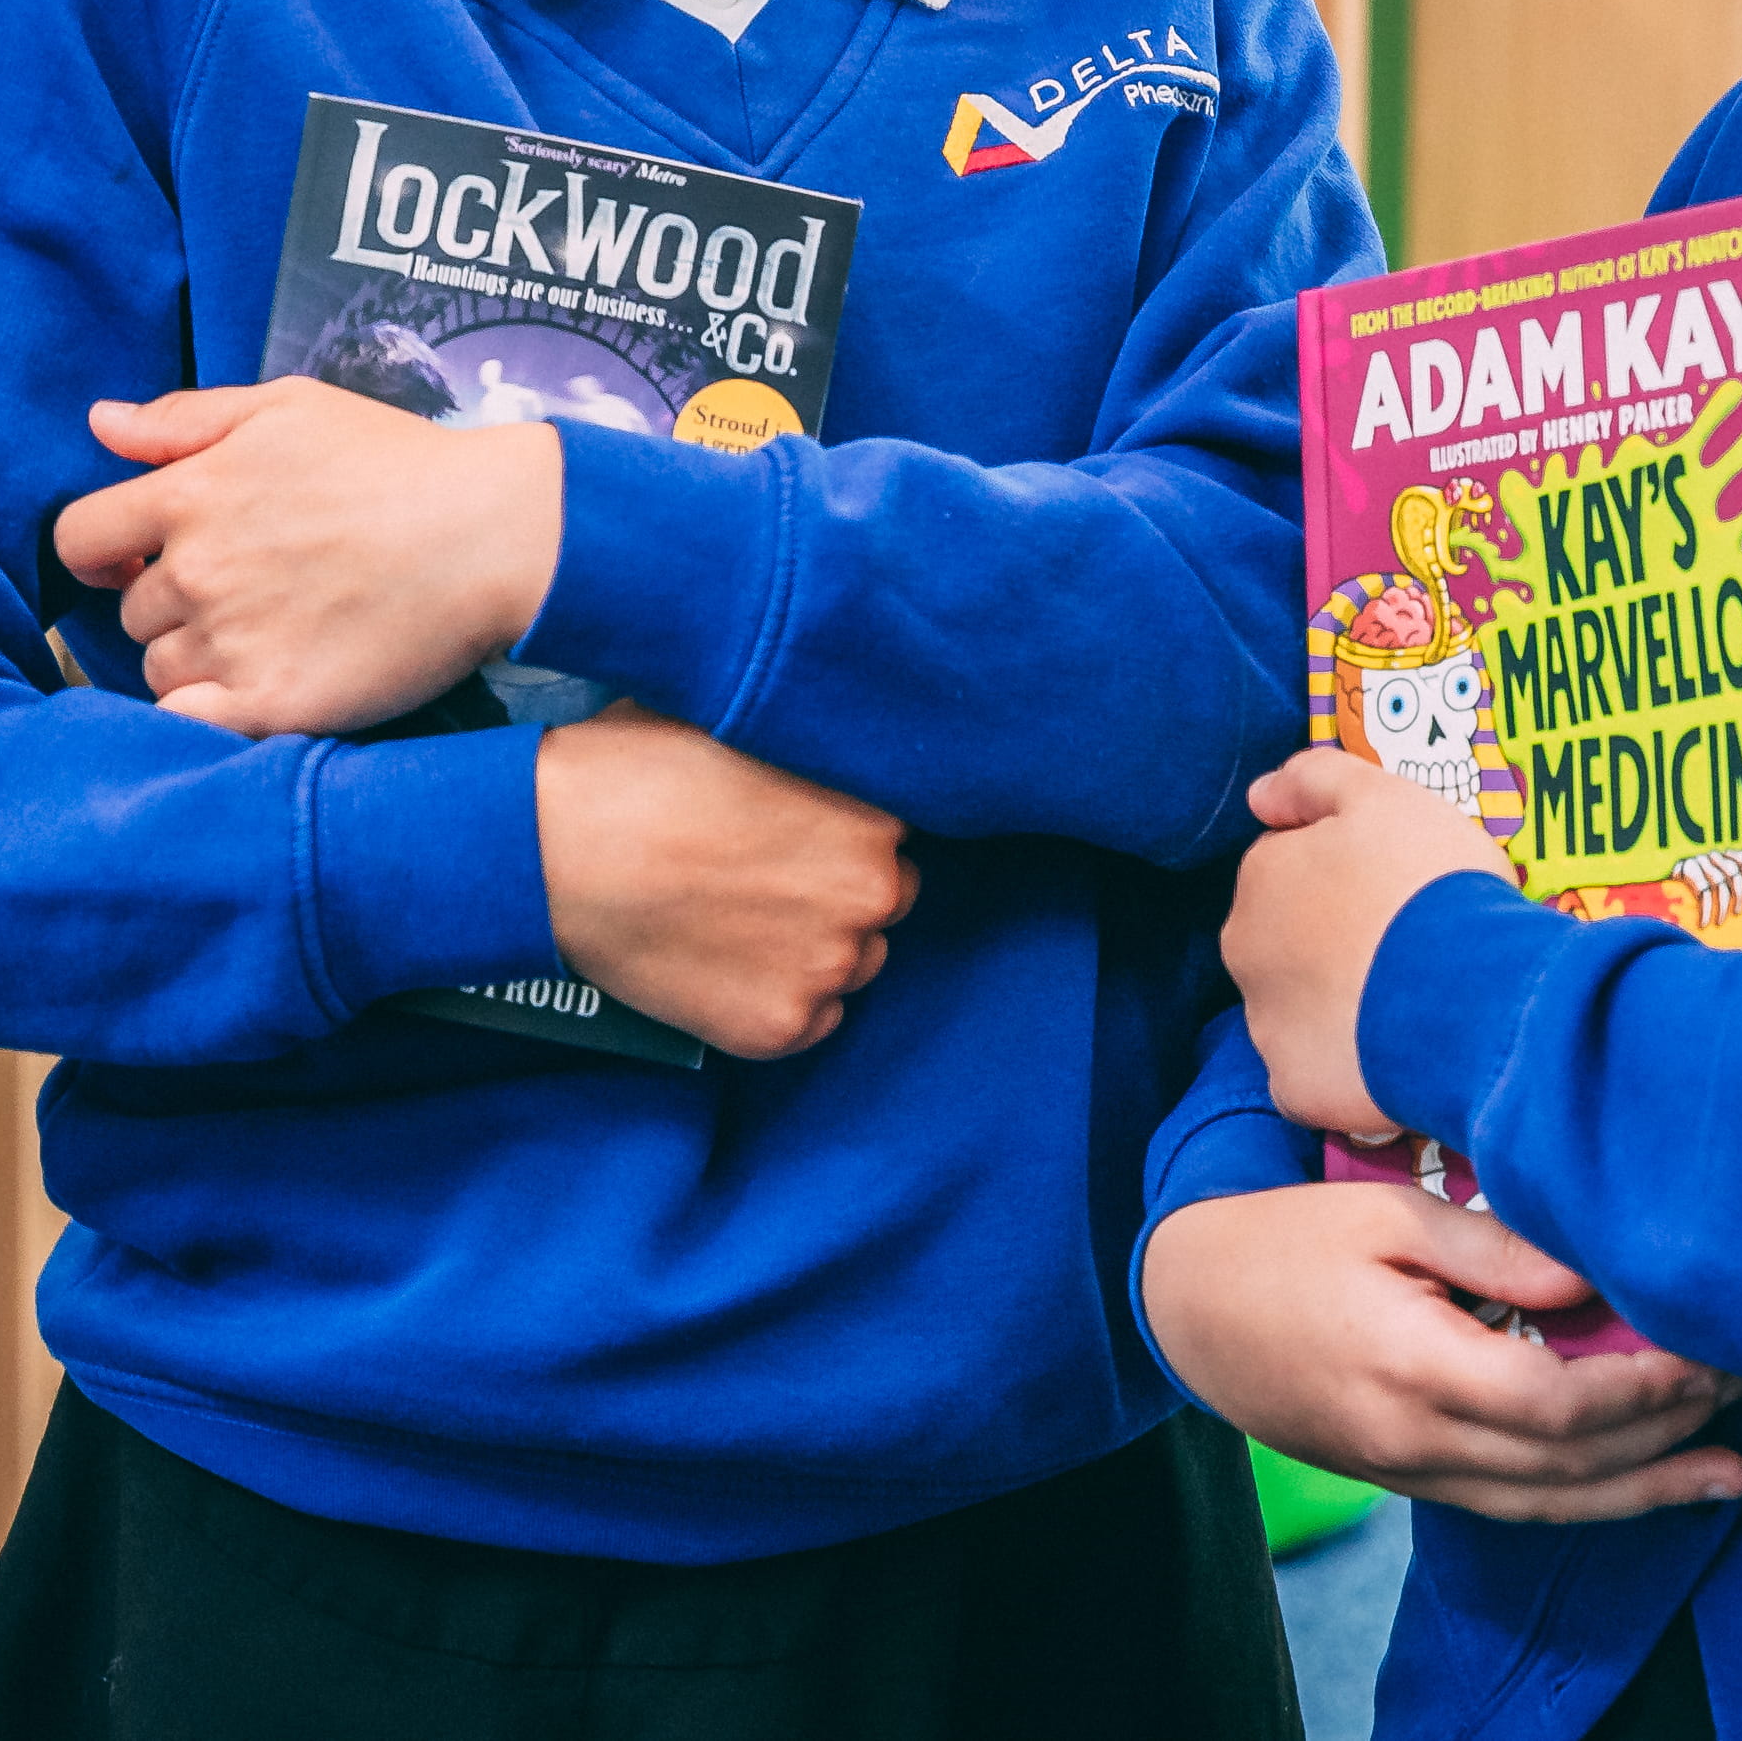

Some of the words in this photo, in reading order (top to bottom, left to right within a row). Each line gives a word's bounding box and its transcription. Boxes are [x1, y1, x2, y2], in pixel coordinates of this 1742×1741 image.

[1030, 25, 1198, 112] DELTA
[635, 162, 687, 187] Metro
[412, 255, 509, 296] Hauntings
[511, 279, 545, 302] are
[547, 286, 582, 310] our
[1350, 309, 1389, 339] FROM
[1390, 302, 1414, 330] THE
[1416, 272, 1556, 324] RECORD-BREAKING
[1559, 259, 1615, 294] AUTHOR
[1616, 253, 1637, 282] OF
[1638, 240, 1685, 278] KAY'S
[1351, 310, 1586, 450] ADAM
[1429, 432, 1518, 473] ILLUSTRATED
[1519, 429, 1539, 455] BY
[1542, 409, 1613, 451] HENRY
[1618, 393, 1694, 437] PAKER
[1539, 454, 1697, 606] KAY'S
